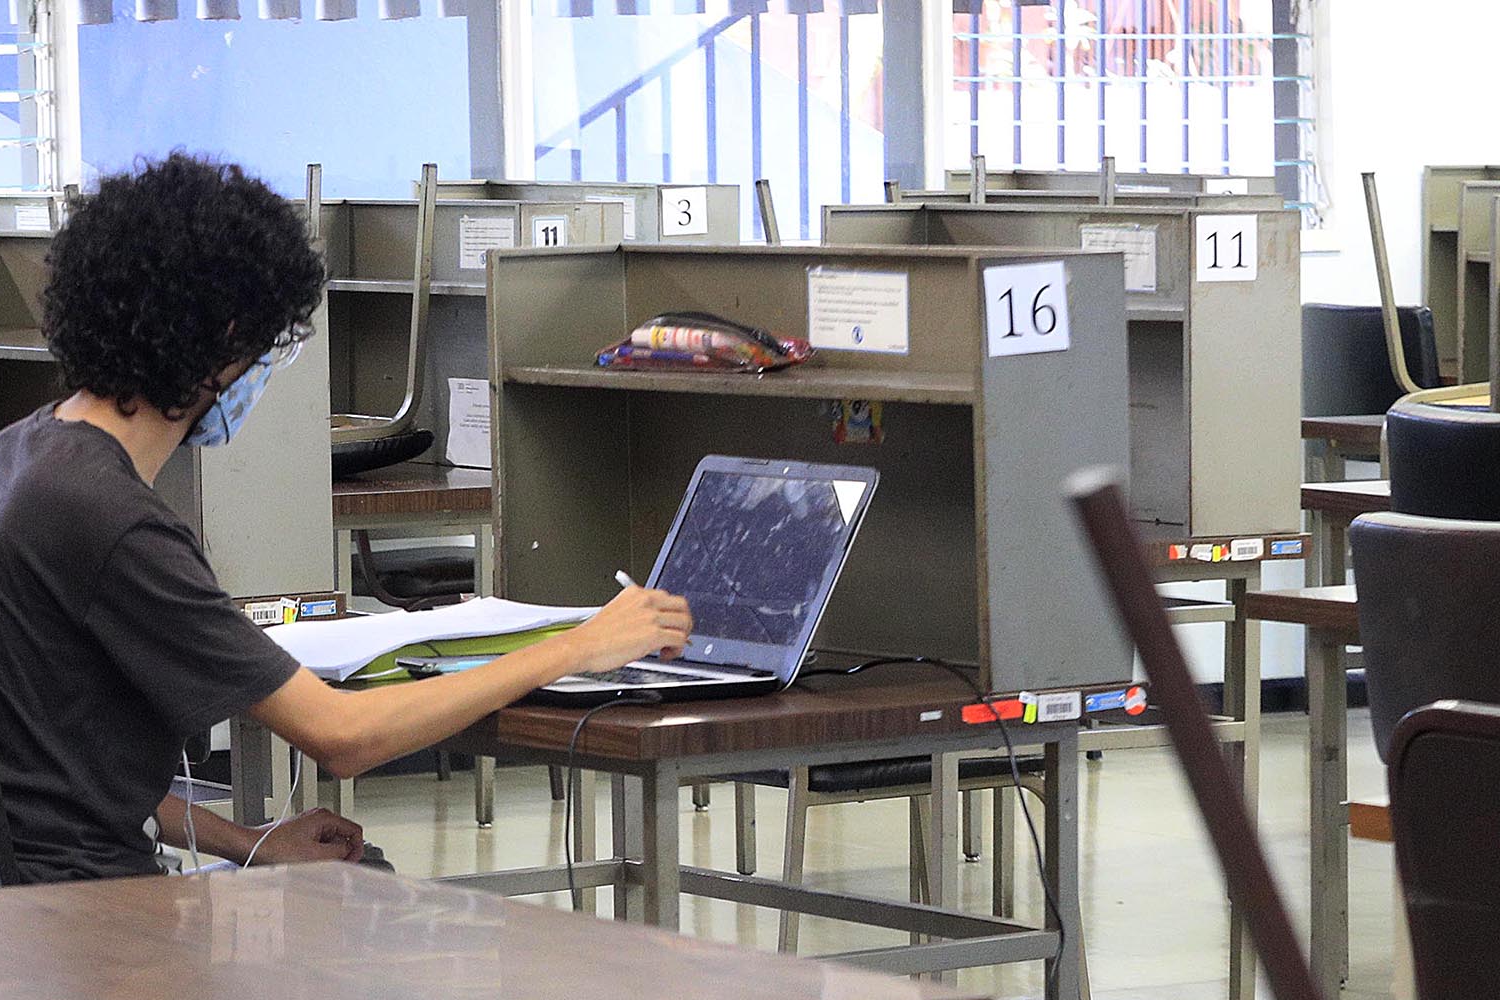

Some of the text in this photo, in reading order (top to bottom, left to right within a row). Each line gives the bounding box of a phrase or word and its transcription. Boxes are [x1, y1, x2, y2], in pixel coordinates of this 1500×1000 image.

[678, 199, 692, 226] 3
[541, 226, 558, 246] 11
[1205, 231, 1249, 269] 11
[996, 284, 1058, 339] 16
